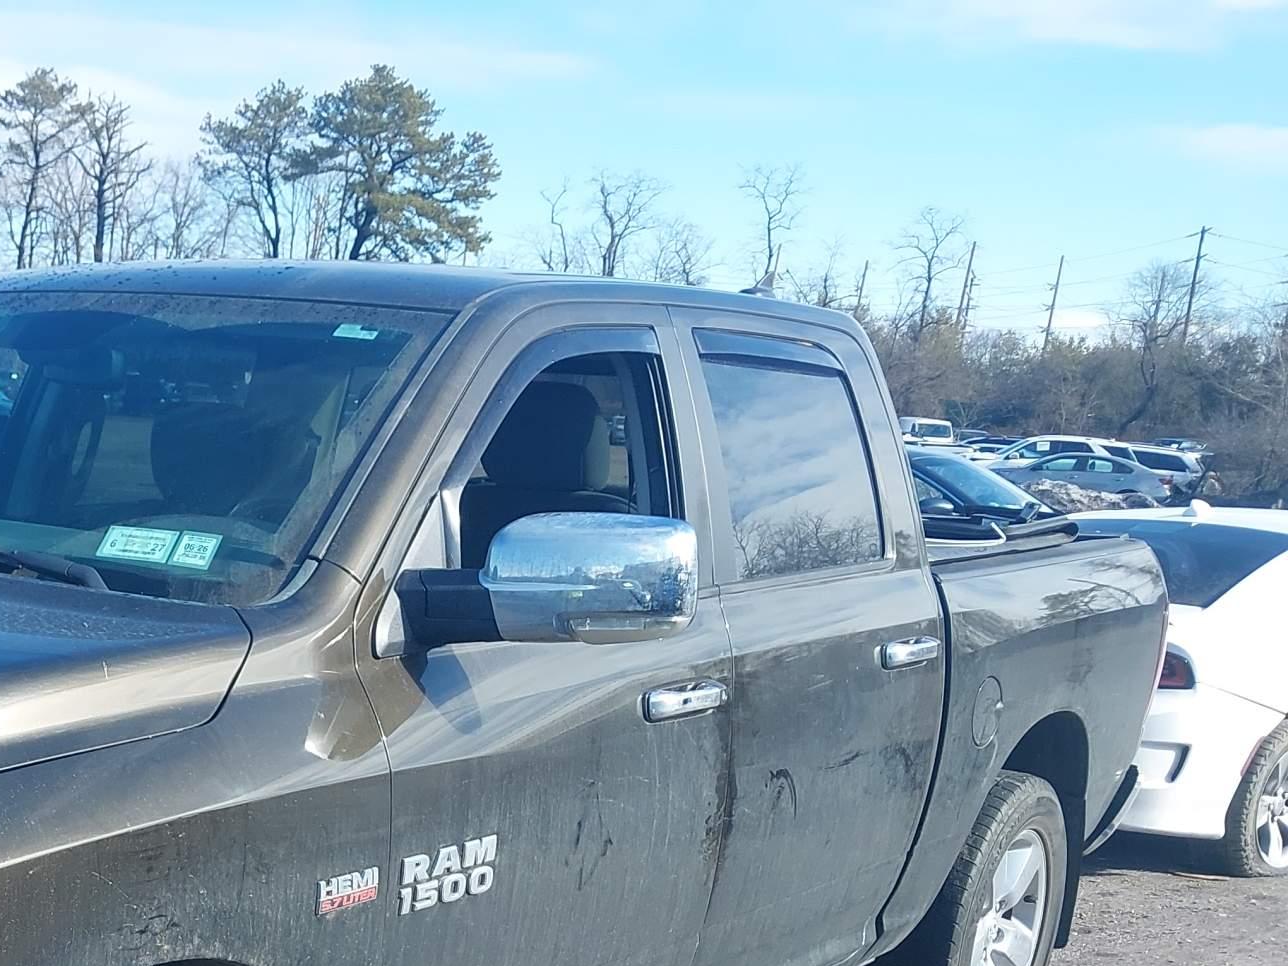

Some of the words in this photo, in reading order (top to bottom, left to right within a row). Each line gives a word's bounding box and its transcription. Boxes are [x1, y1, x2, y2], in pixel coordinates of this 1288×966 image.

[401, 834, 498, 884] RAM
[318, 866, 379, 899] HEMI
[343, 888, 376, 906] LITER
[398, 865, 494, 915] 1500
